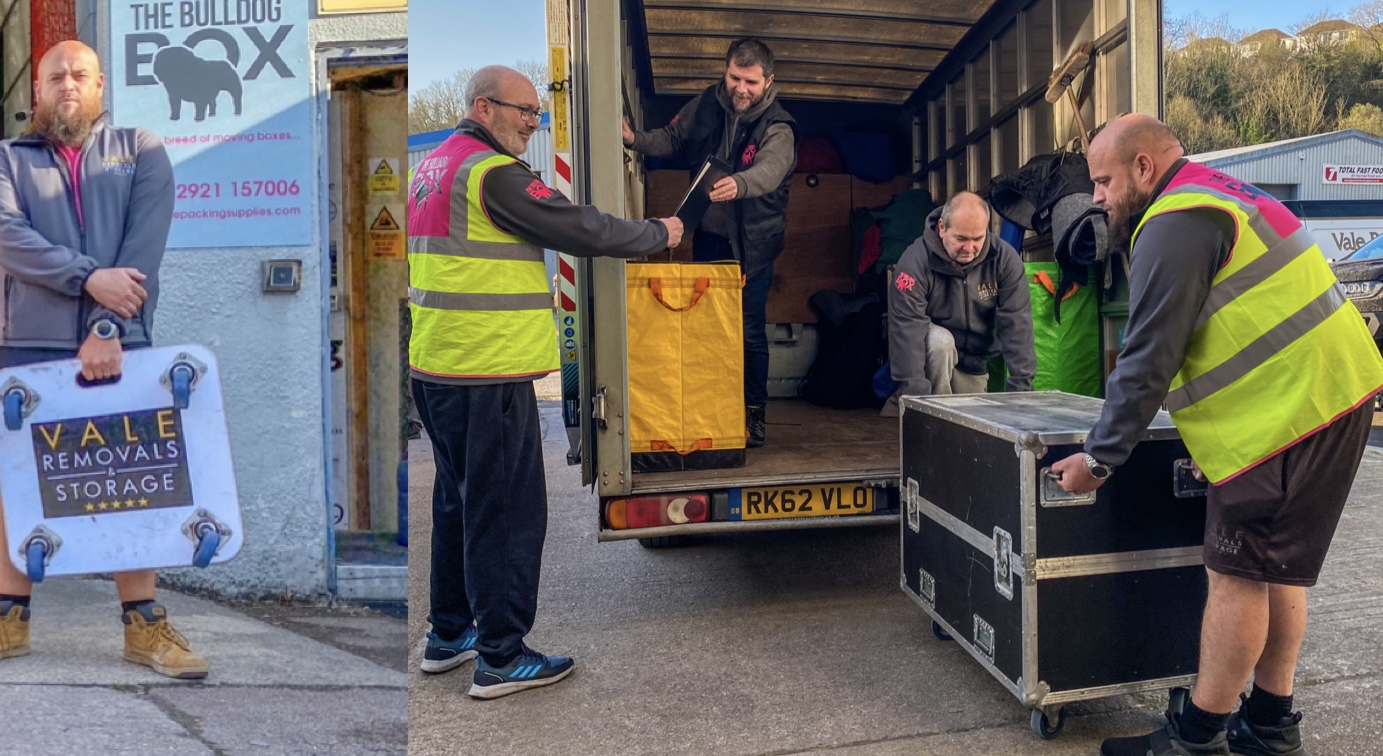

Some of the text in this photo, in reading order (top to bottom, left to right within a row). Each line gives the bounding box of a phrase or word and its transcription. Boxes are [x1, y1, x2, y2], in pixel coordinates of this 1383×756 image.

[130, 0, 281, 30] THE BULLDOG
[164, 134, 197, 145] breed
[200, 133, 210, 143] of
[213, 132, 254, 143] moving
[1339, 166, 1356, 174] TOTAL
[176, 179, 301, 199] 2921 157006
[1331, 232, 1365, 251] Vale
[38, 410, 176, 450] VALE
[42, 440, 179, 472] REMOVALS
[107, 467, 116, 476] &
[55, 473, 175, 502] STORAGE
[747, 489, 812, 515] RK62
